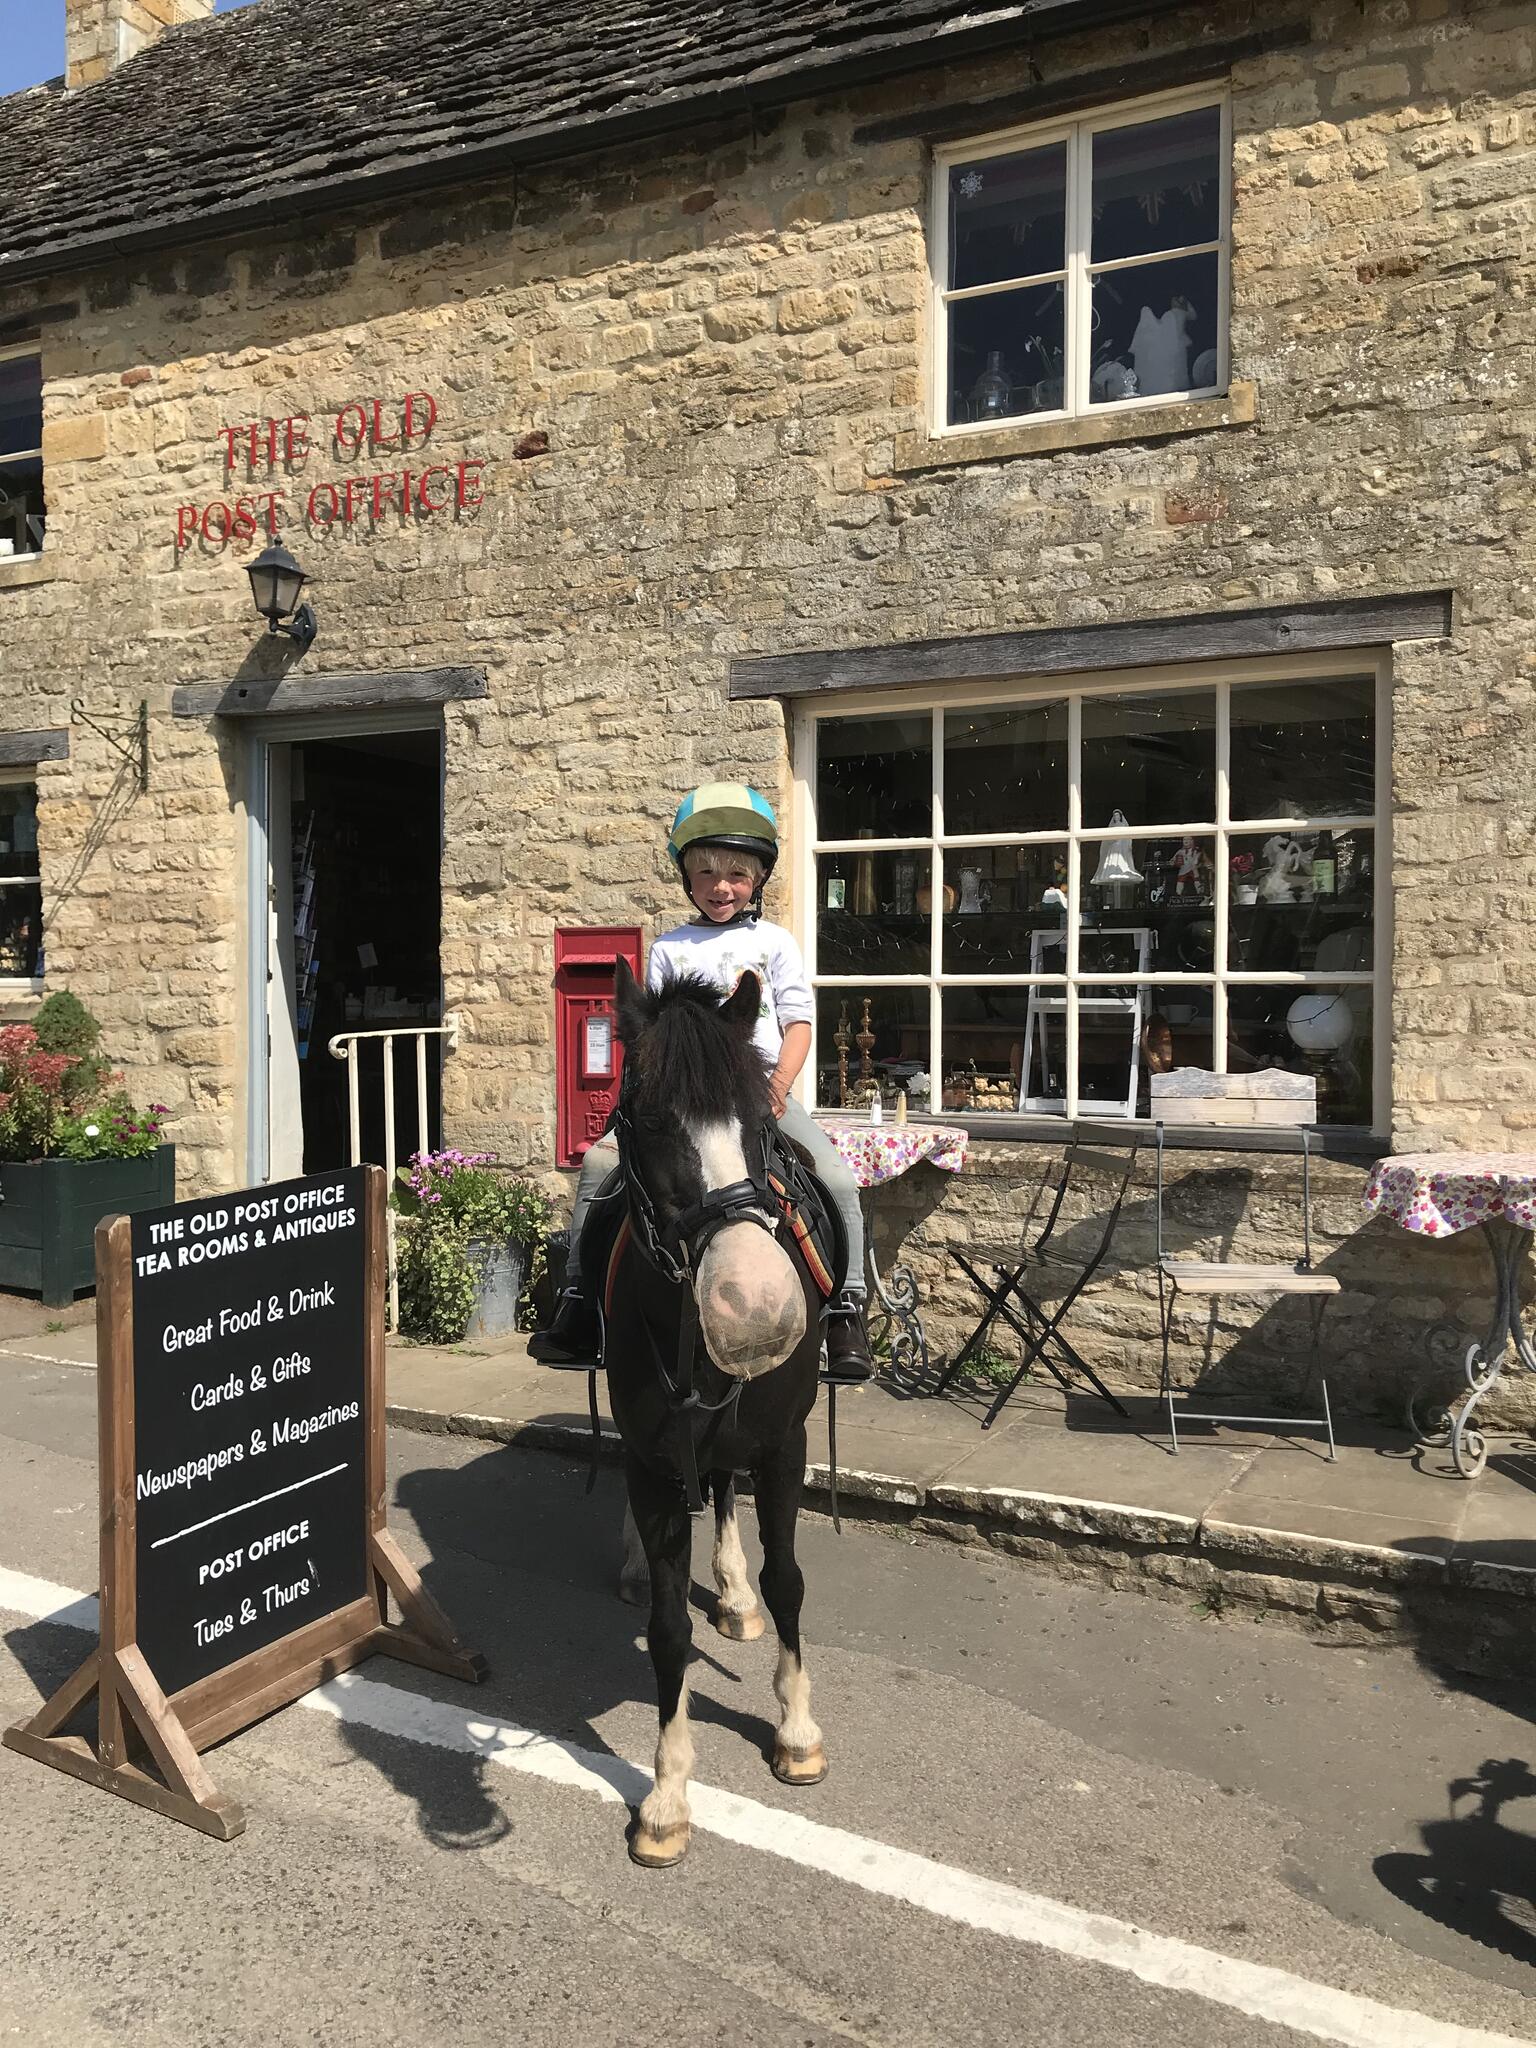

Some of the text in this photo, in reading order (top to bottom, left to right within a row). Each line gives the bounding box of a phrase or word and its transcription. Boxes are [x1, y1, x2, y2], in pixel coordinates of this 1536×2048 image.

[218, 391, 437, 469] THE OLD
[176, 460, 486, 547] POST OFFICE
[136, 1208, 356, 1277] TEA ROOMS & ANTIQUES
[150, 1184, 345, 1244] THE OLD POST OFFICE
[162, 1281, 335, 1353] Great Food & Drink
[190, 1352, 312, 1411] Cards & Gifts
[136, 1401, 359, 1500] Newspapers & Magazines
[198, 1519, 310, 1585] POST OFFICE
[193, 1577, 310, 1647] Tues & Thurs
